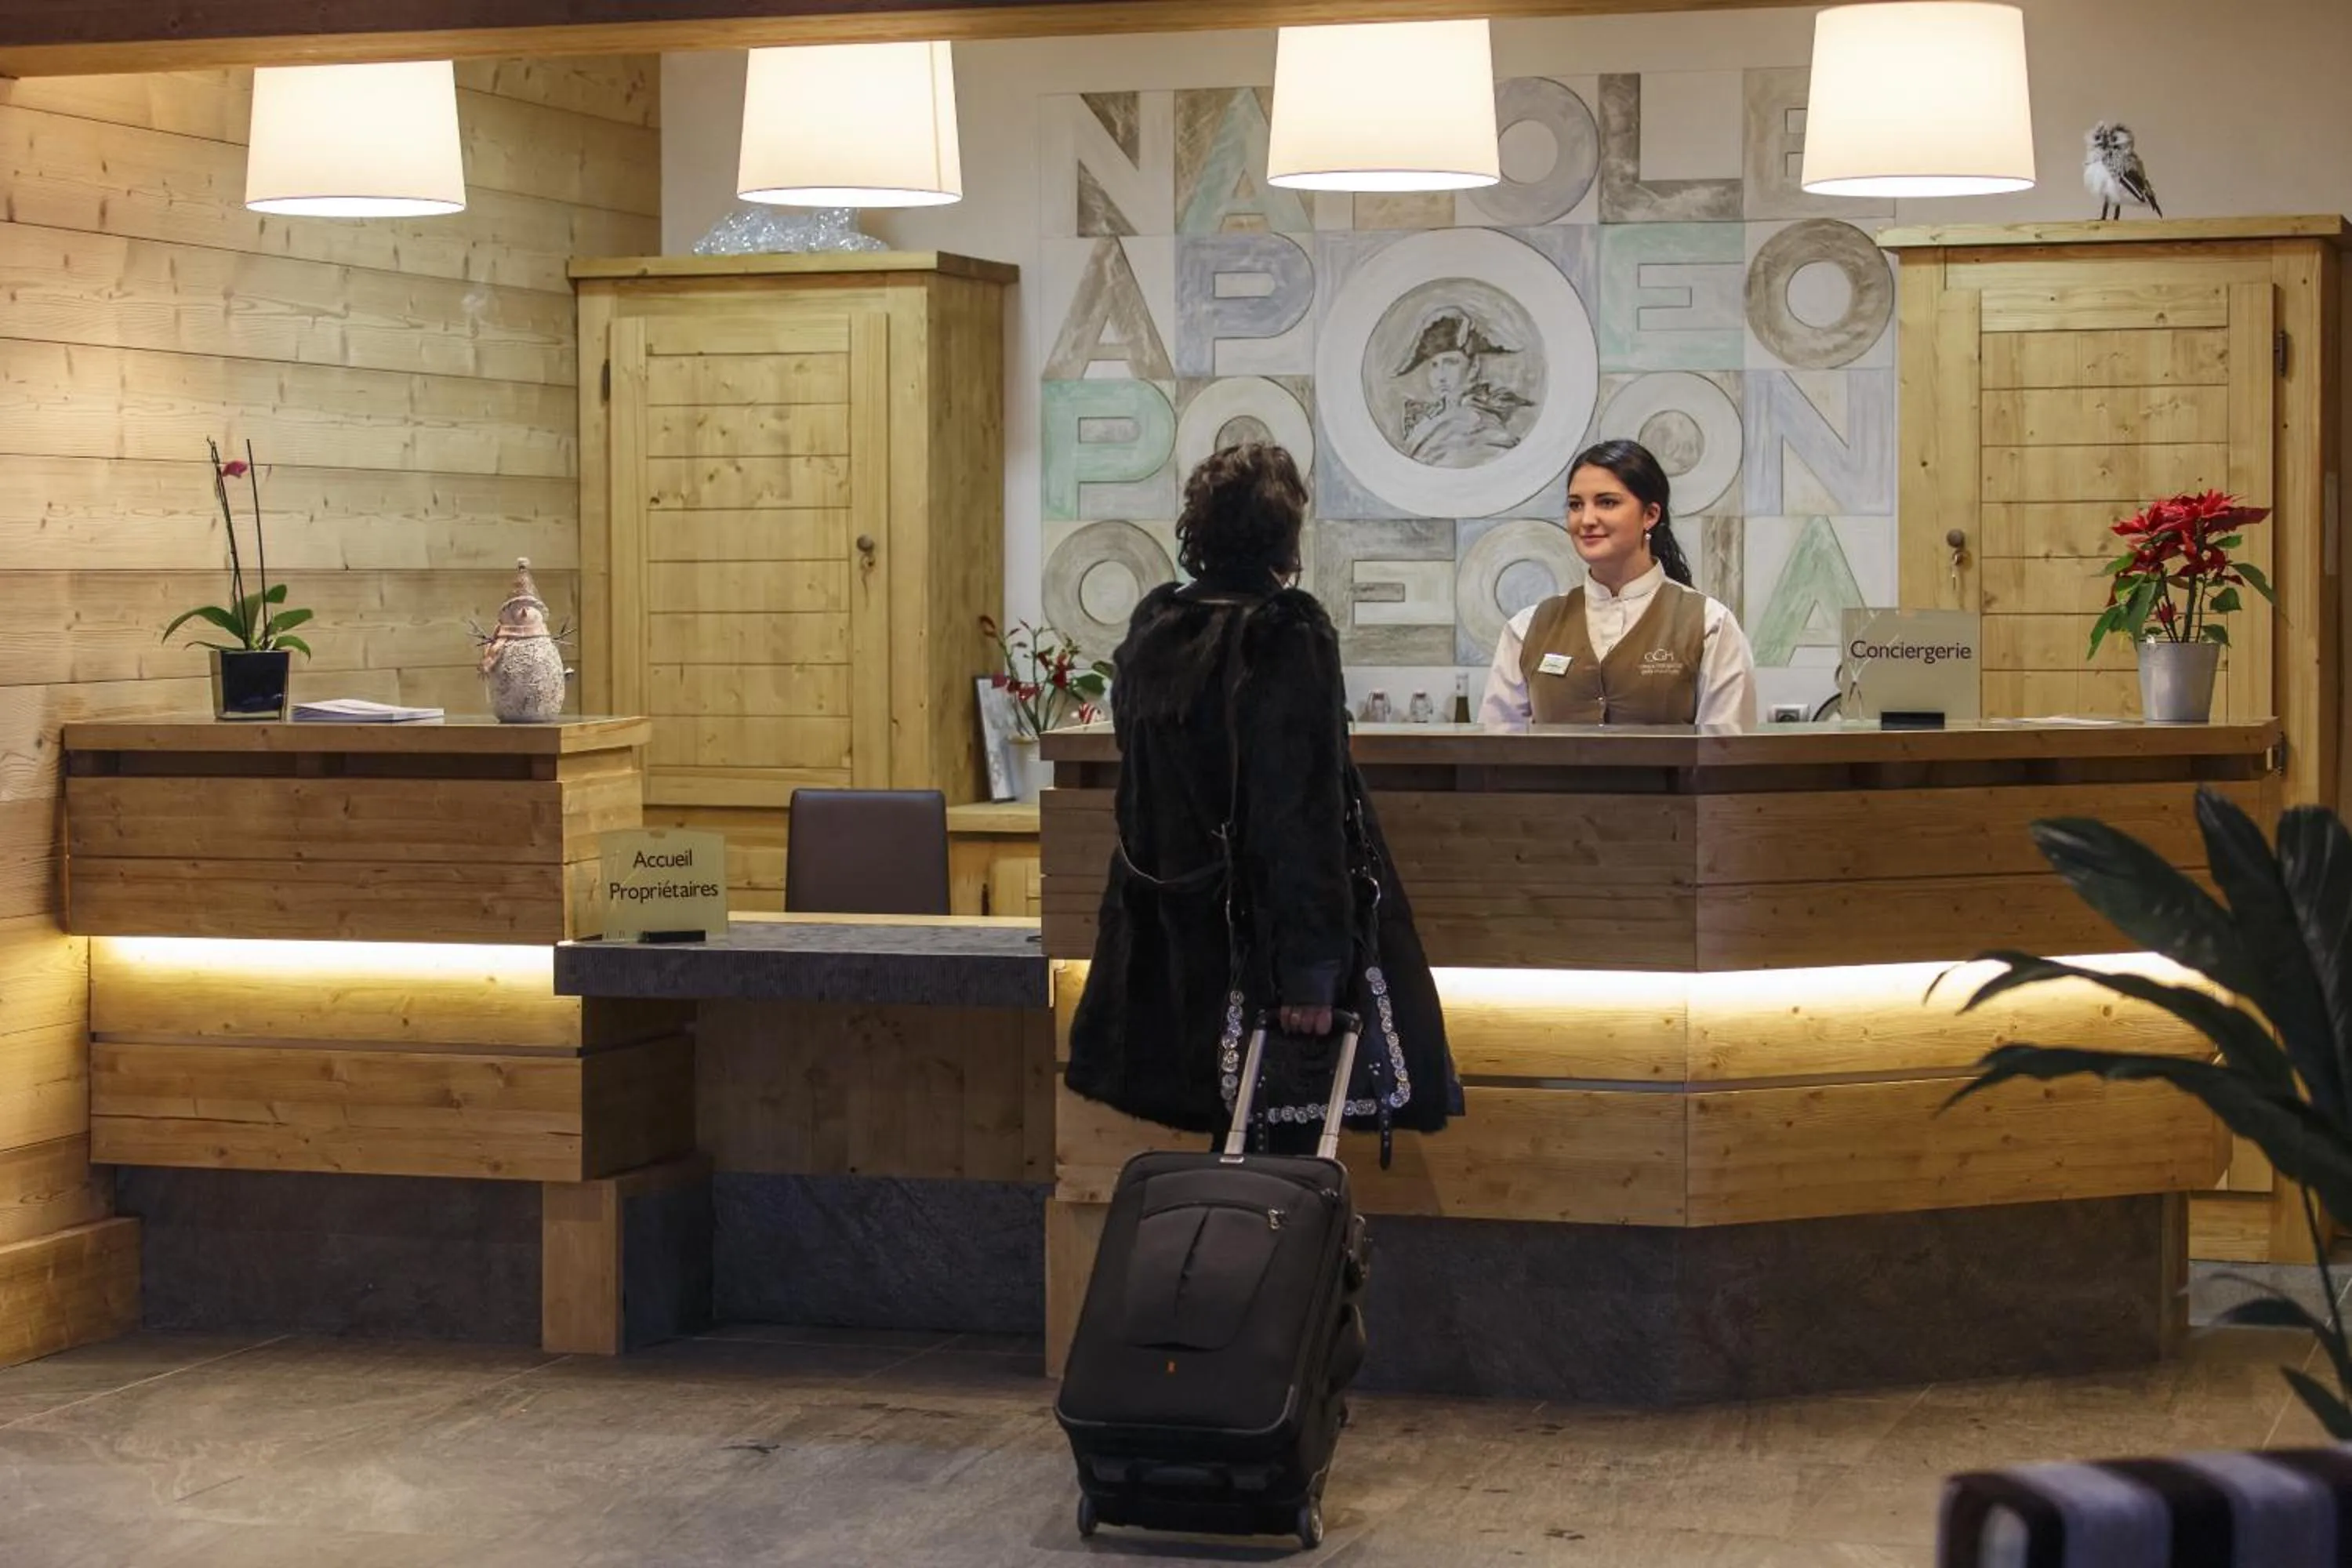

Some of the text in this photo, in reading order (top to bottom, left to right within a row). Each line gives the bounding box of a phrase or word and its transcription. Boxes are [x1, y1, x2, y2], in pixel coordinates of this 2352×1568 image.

[1850, 640, 1973, 664] Conciergerie
[633, 848, 693, 869] Accueil
[609, 880, 719, 903] Propriétaires
